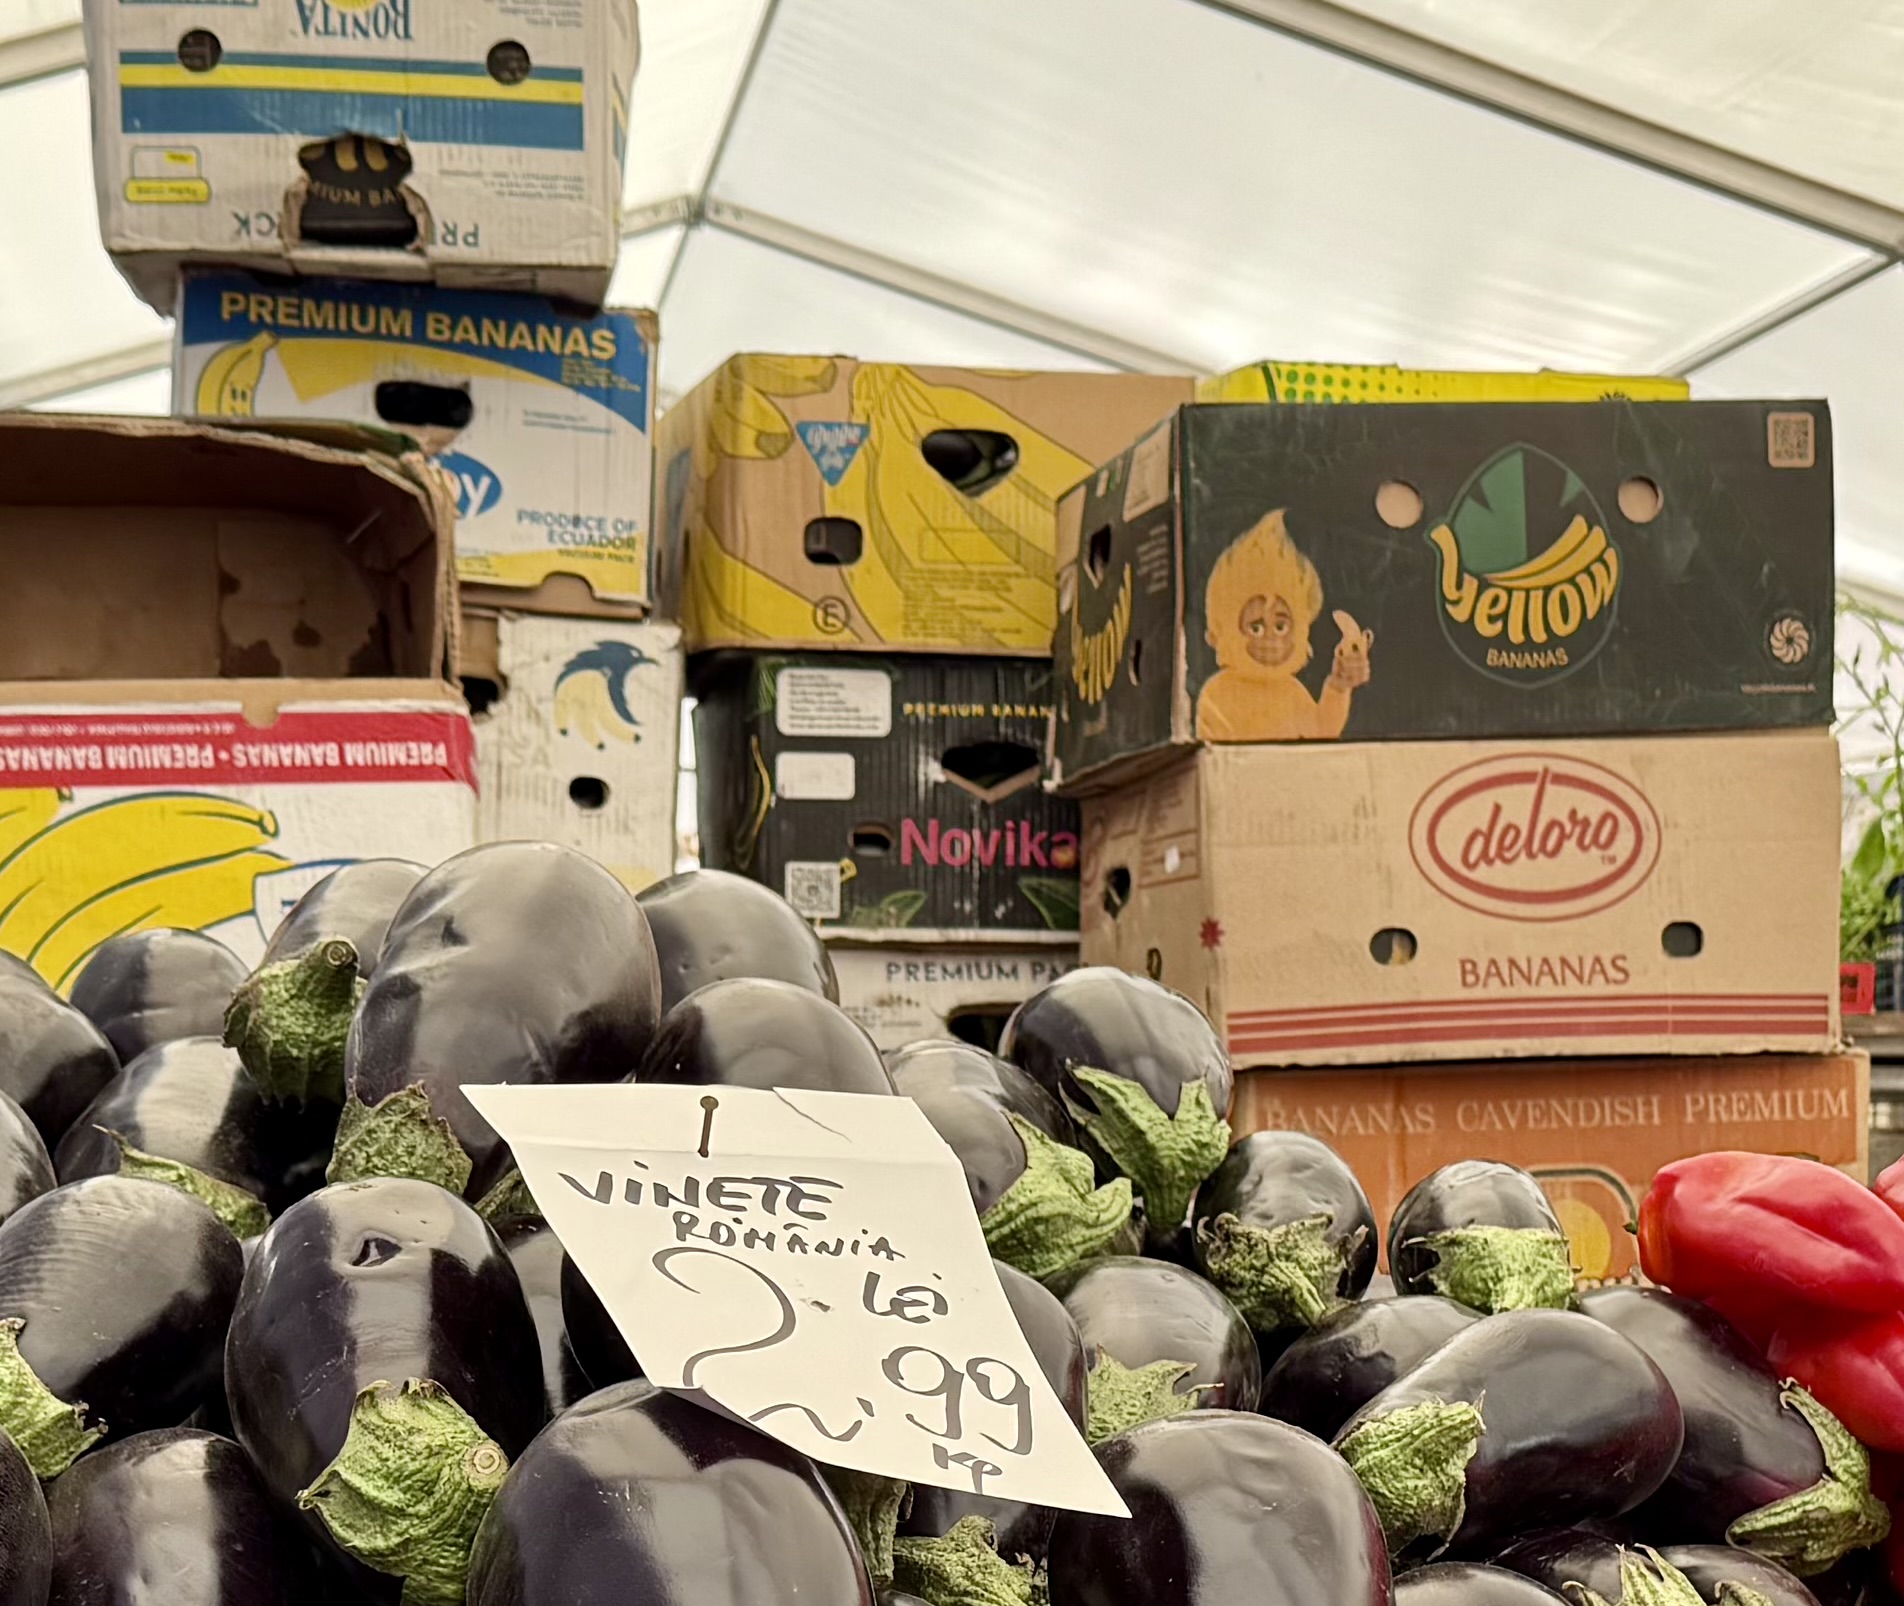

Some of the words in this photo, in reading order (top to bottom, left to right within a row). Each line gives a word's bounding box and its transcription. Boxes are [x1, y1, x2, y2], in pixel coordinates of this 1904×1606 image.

[221, 292, 413, 338] PREMIUM
[426, 313, 617, 360] BANANAS
[516, 509, 608, 532] PRODUCE
[612, 519, 637, 535] OF
[547, 528, 636, 552] ECUADOR
[1487, 647, 1569, 670] BANANAS
[902, 702, 985, 719] PREMIUM
[106, 742, 214, 769] PREMIUM
[233, 741, 340, 767] BANANAS
[344, 741, 447, 766] PREMIUM
[1462, 767, 1618, 872] deloro
[900, 817, 1080, 869] Novika
[885, 960, 1019, 983] PREMIUM
[1458, 953, 1630, 989] BANANAS
[1265, 1100, 1436, 1138] BANANAS
[1457, 1095, 1661, 1132] CAVENDISH
[1684, 1087, 1850, 1124] PREMIUM
